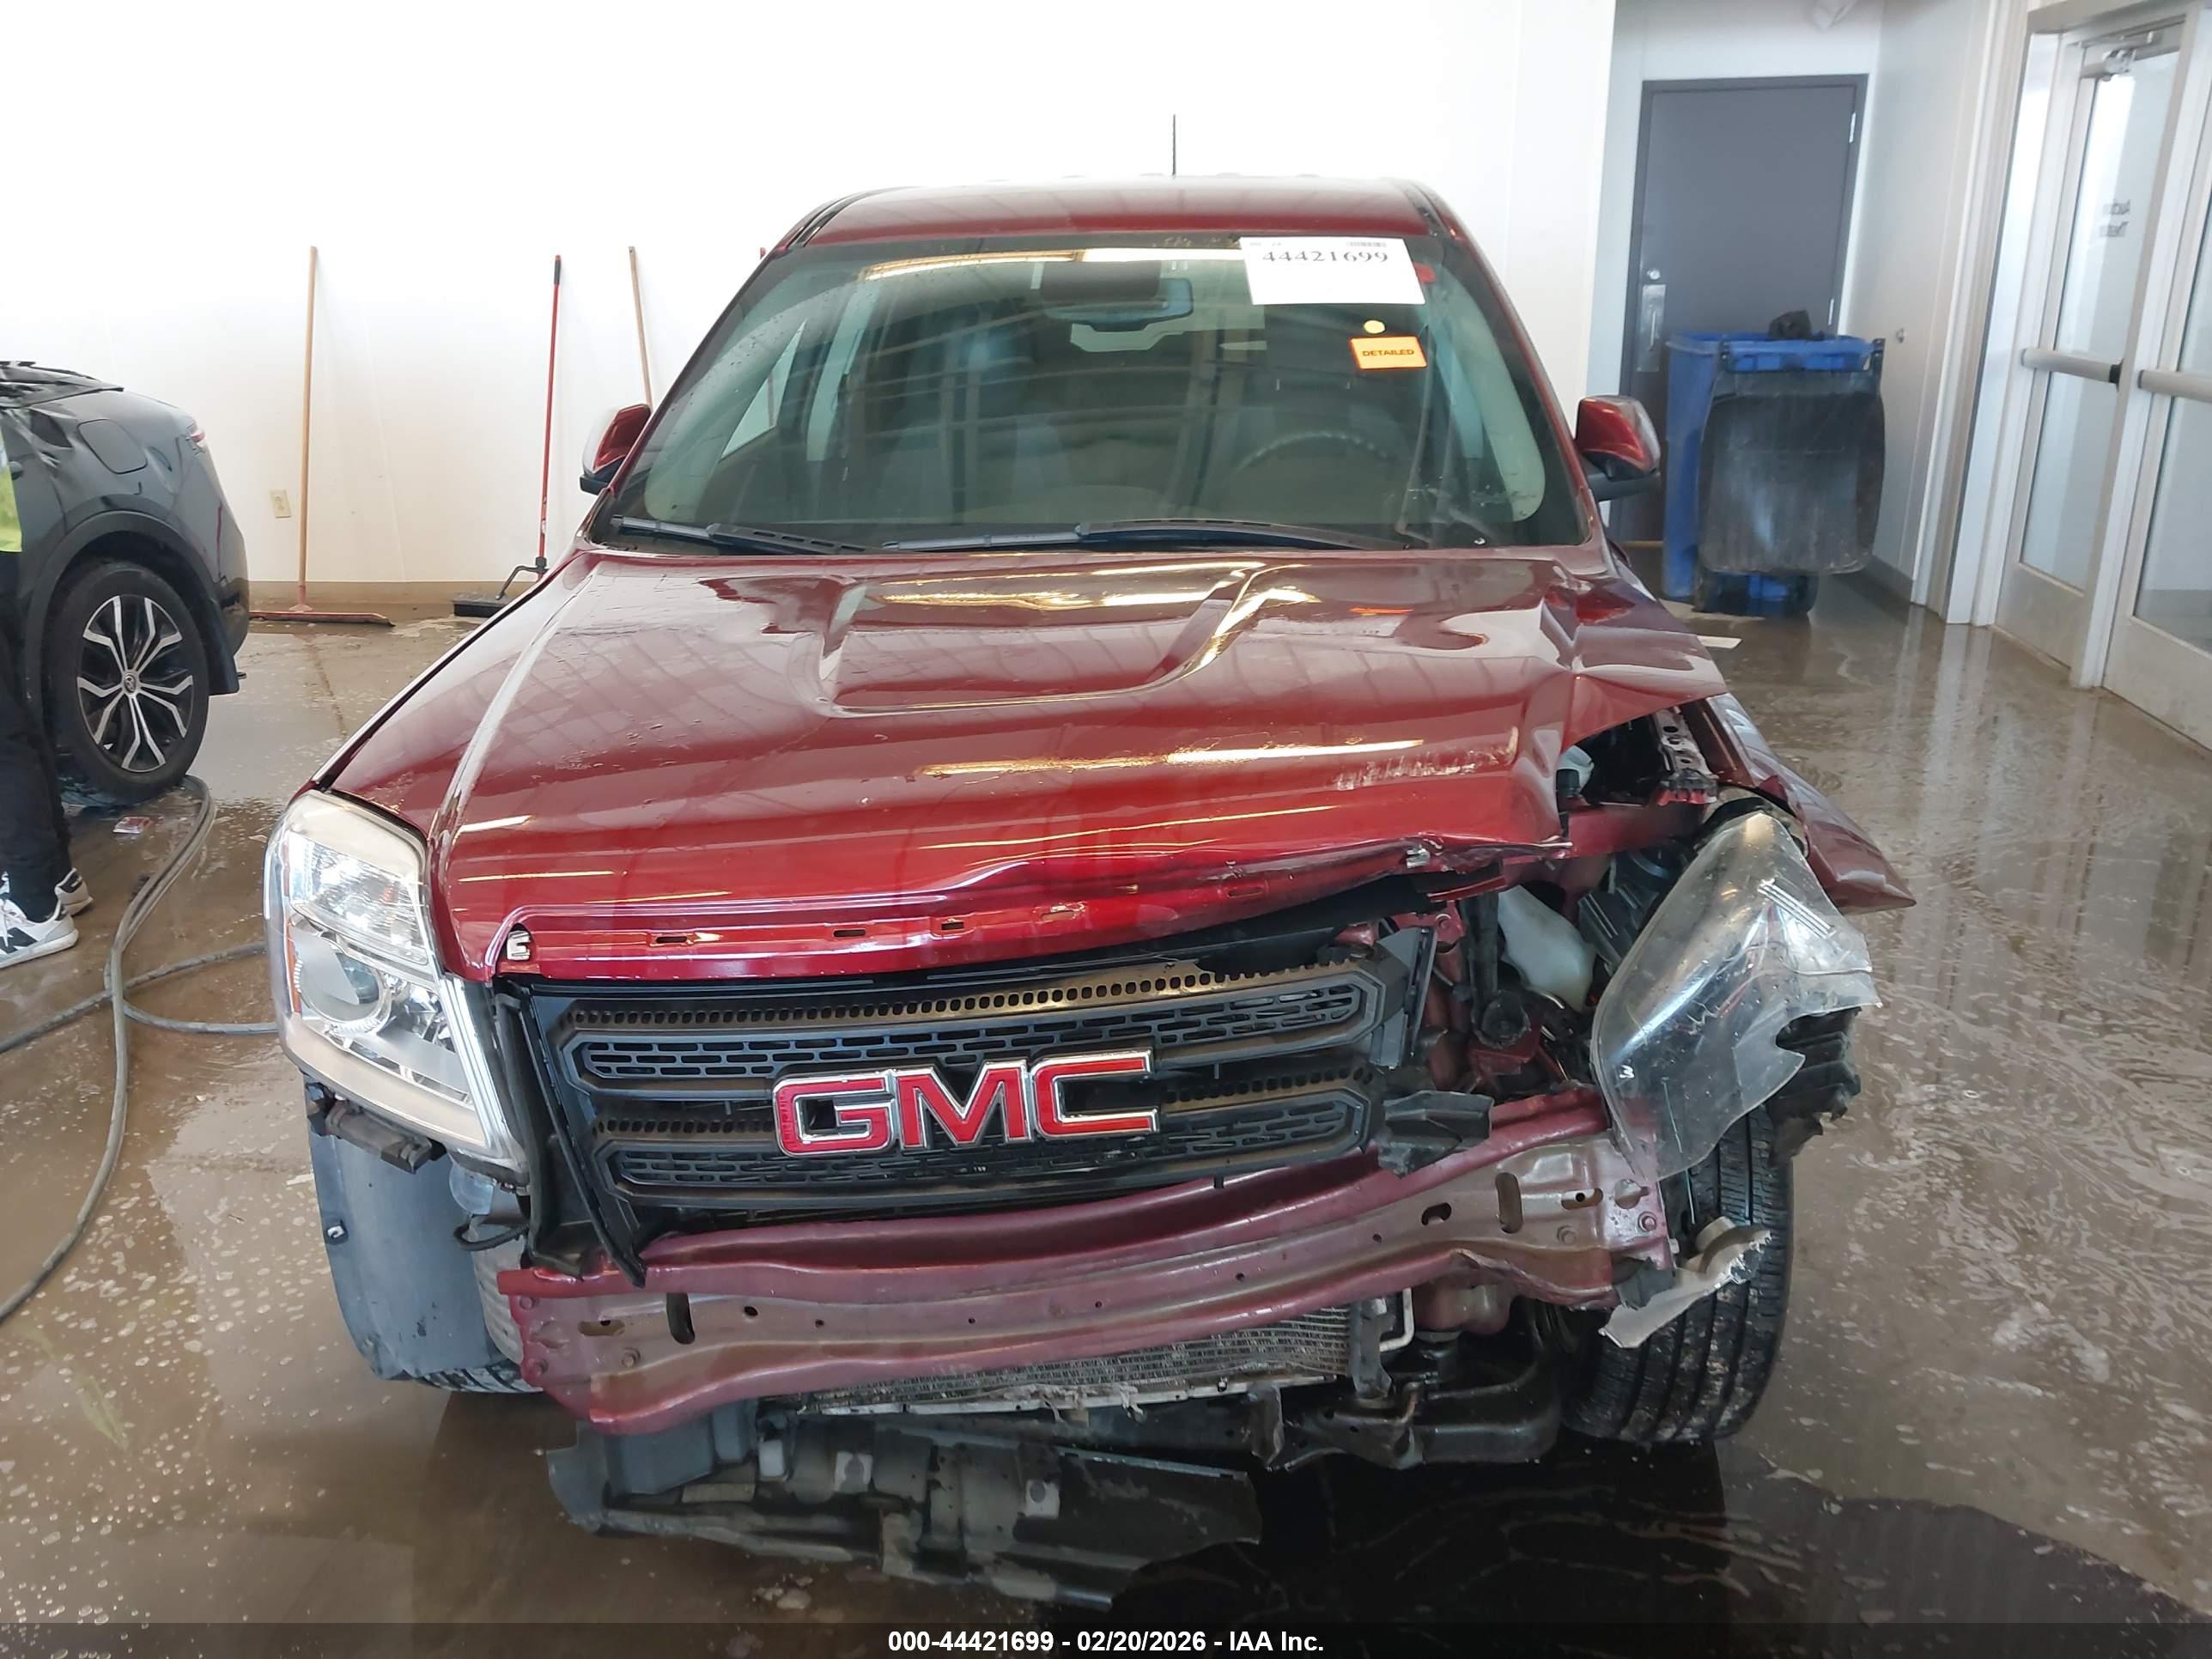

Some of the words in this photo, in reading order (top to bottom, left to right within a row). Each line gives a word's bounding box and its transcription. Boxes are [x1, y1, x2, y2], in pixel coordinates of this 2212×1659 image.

[1261, 250, 1389, 263] 44421699
[1361, 349, 1415, 357] DETAILED
[773, 1048, 1159, 1158] GMC
